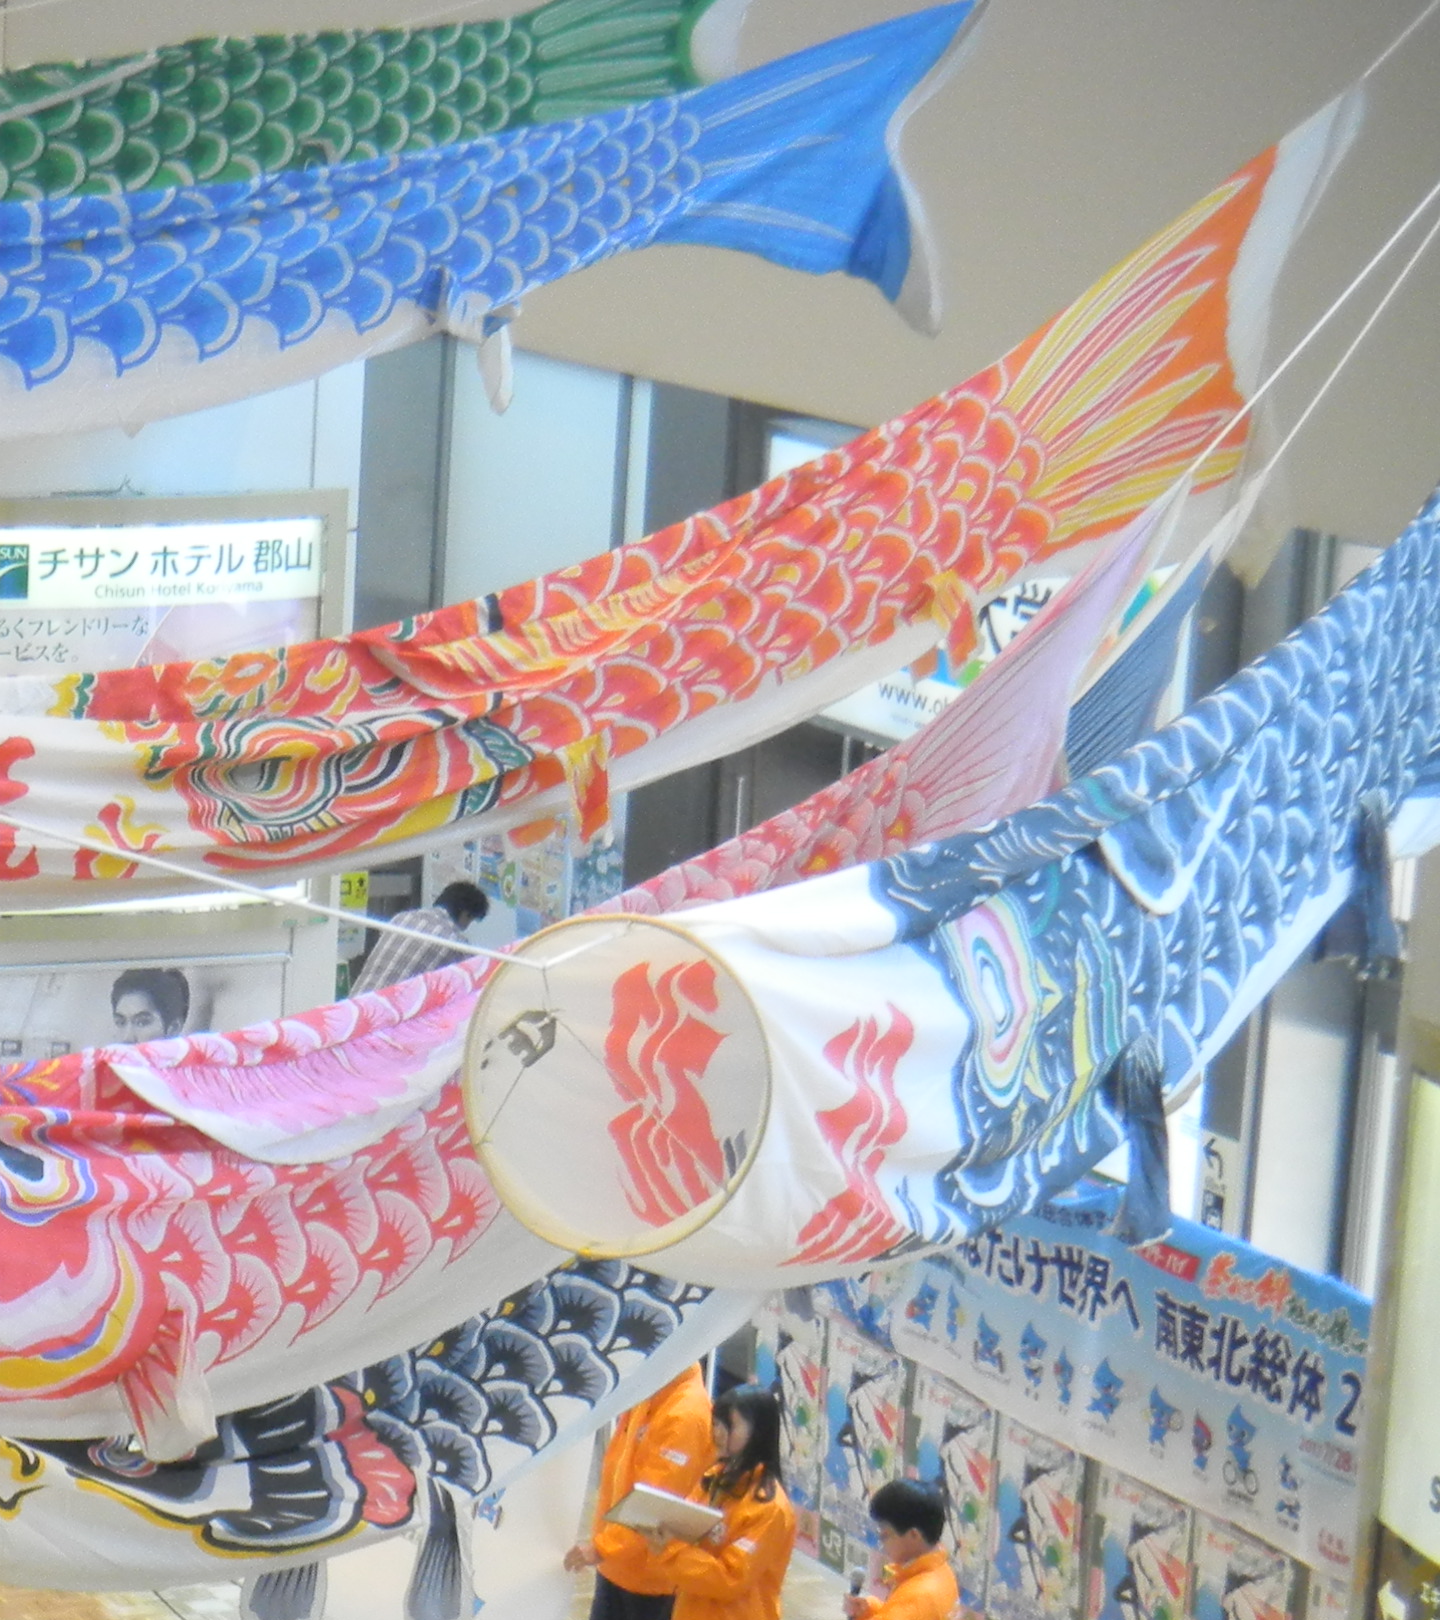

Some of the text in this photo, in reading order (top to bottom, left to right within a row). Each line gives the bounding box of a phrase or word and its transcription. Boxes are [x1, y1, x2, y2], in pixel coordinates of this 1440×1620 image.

[37, 536, 313, 580] チサン ホテル 郡山
[94, 583, 146, 600] Chisun
[151, 581, 192, 597] Hotel
[1154, 1288, 1326, 1422] 南東北総体
